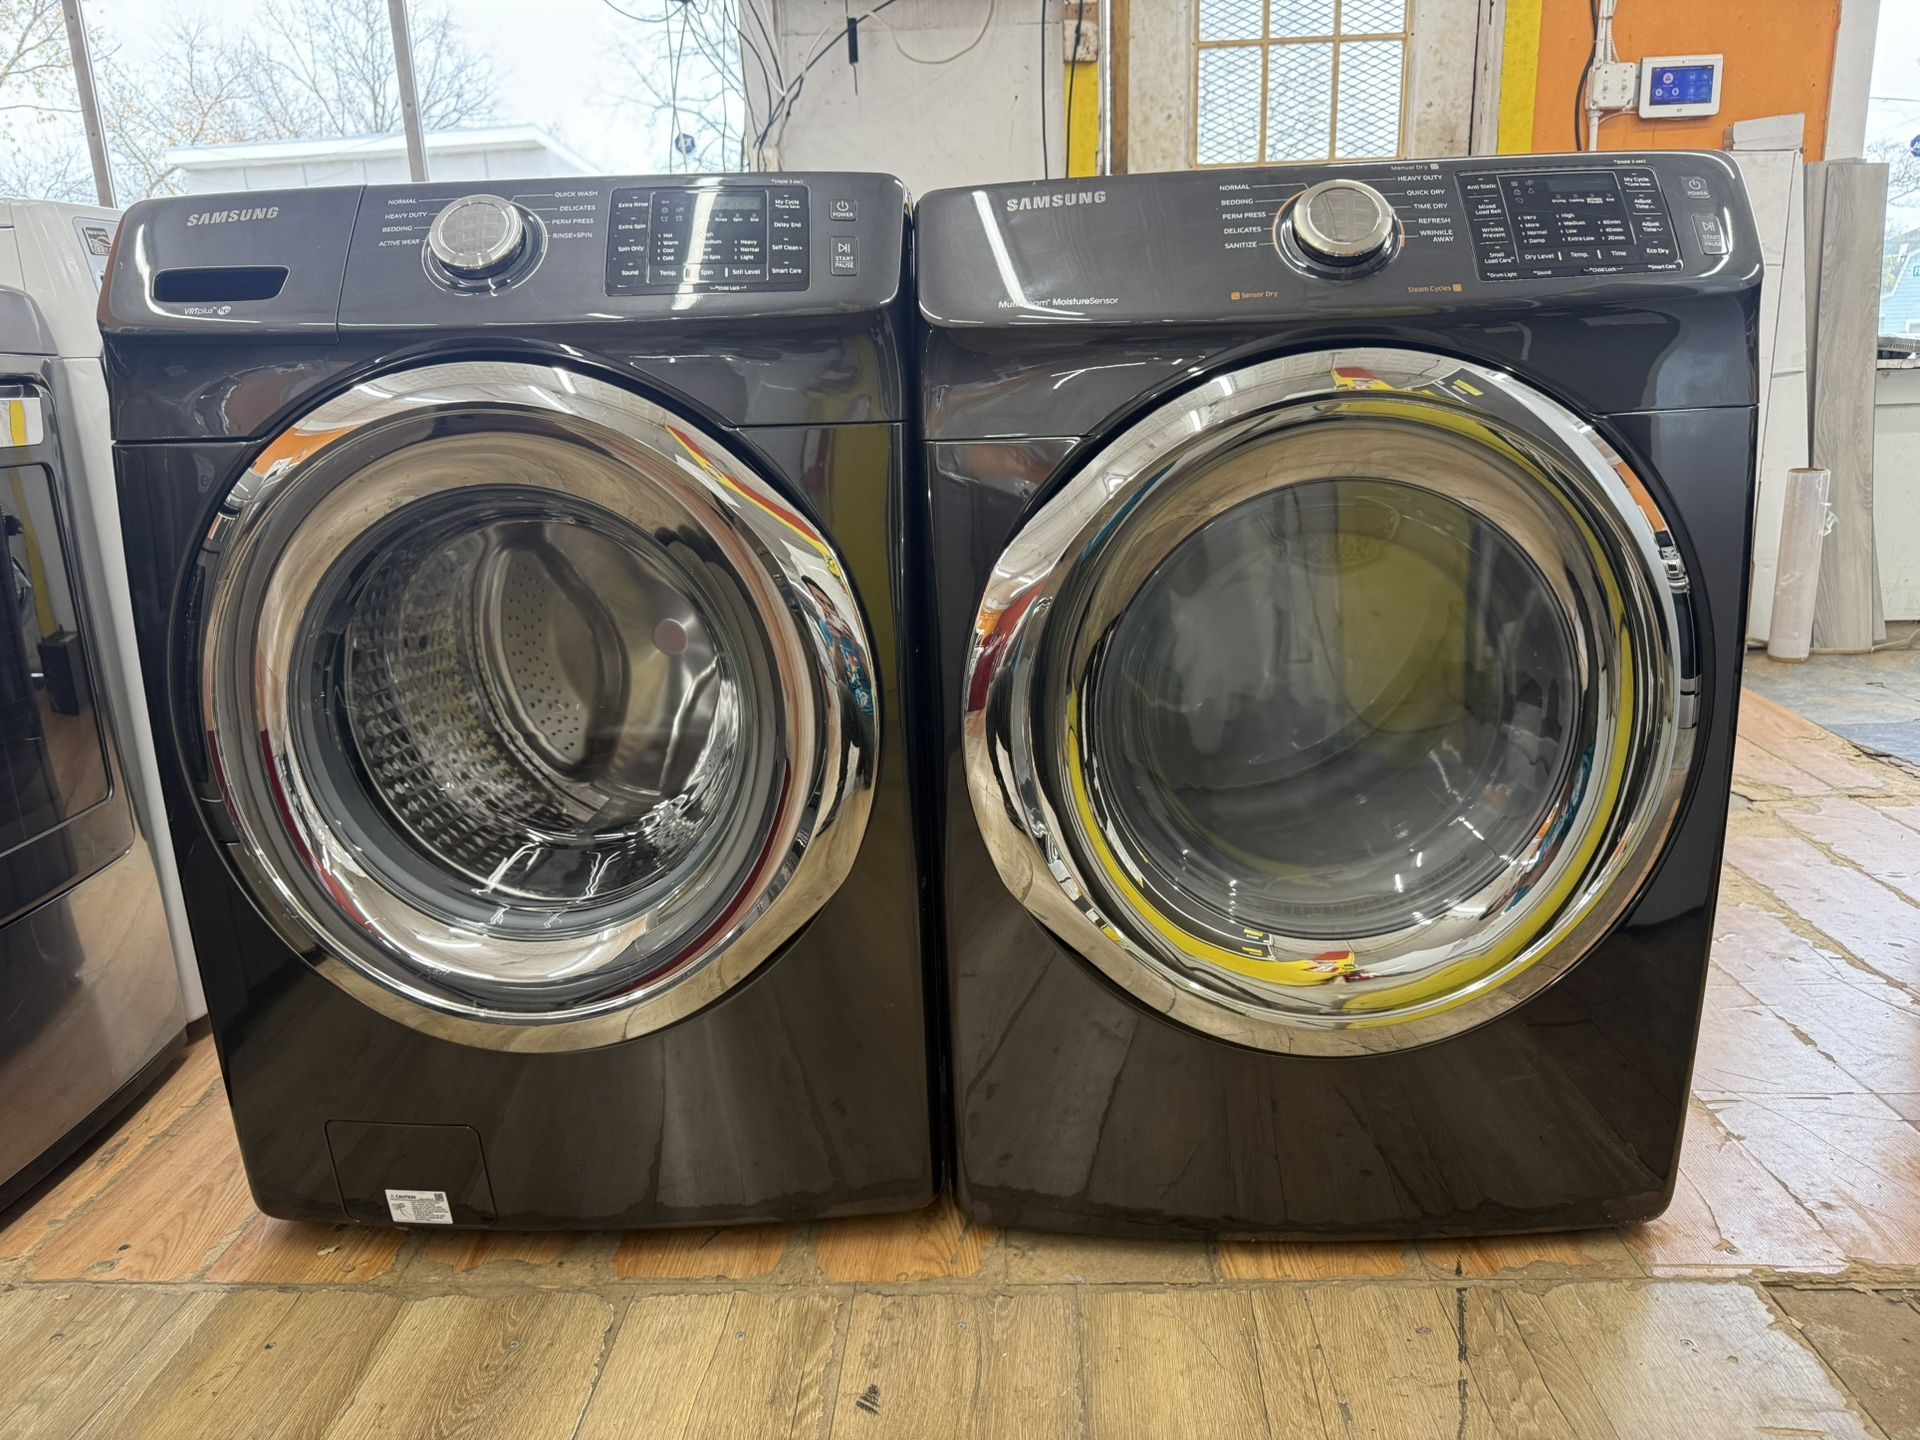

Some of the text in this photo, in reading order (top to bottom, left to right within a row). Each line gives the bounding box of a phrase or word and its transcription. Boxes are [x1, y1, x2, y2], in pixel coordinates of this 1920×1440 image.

[1006, 191, 1107, 212] SAMSUNG
[1221, 198, 1254, 206] BEDDING
[186, 206, 279, 226] SAMSUNG
[1224, 226, 1262, 235] DELICATES
[1224, 241, 1257, 249] SANITIZE
[1052, 297, 1119, 306] MoistureSensor
